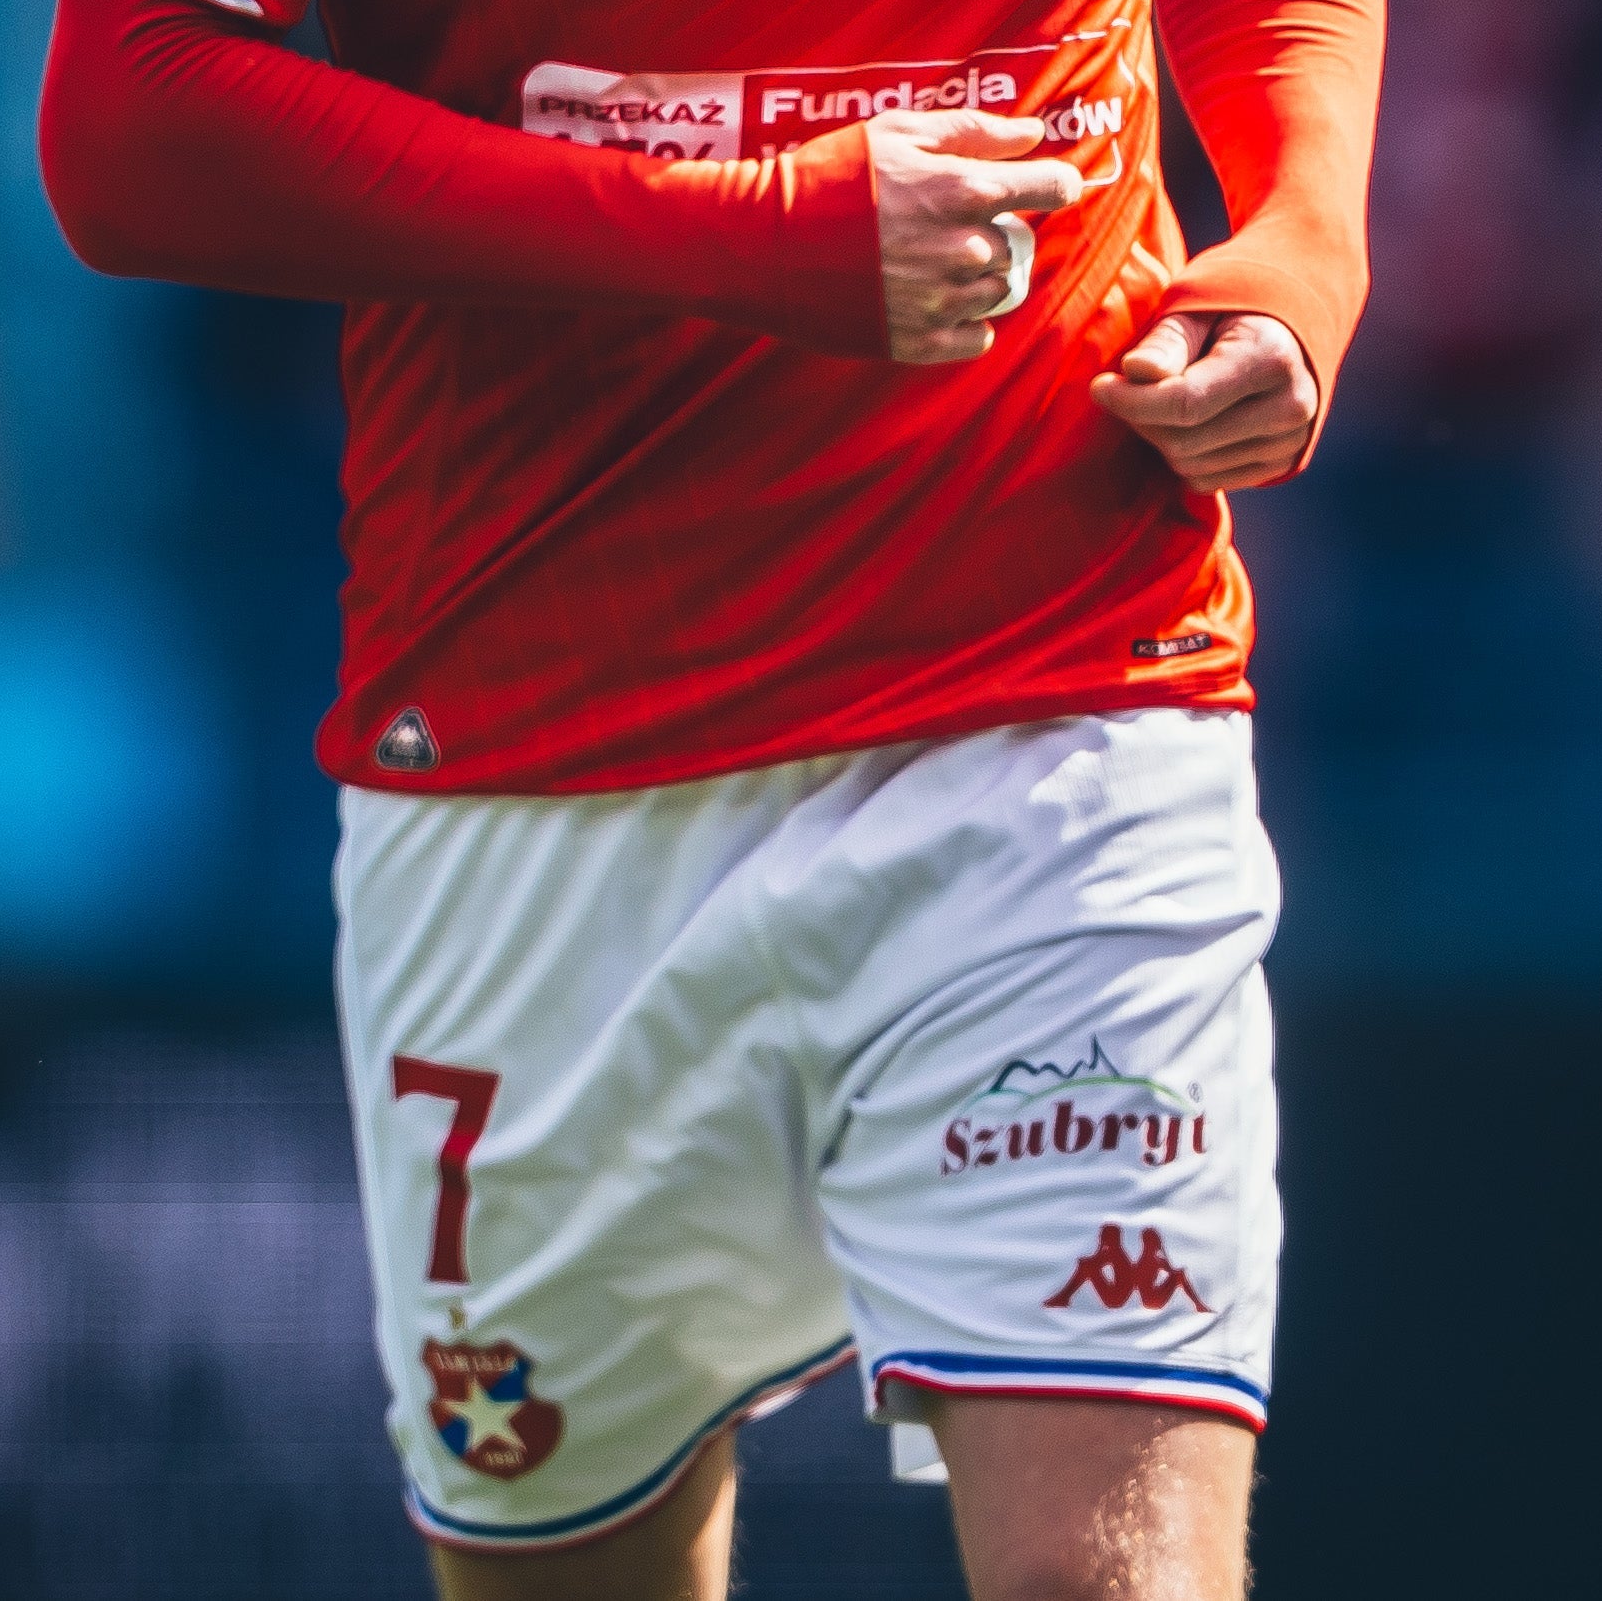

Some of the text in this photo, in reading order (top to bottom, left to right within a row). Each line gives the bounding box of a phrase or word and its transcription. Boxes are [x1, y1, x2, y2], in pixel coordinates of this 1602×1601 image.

[539, 95, 727, 126] PRZEKAŻ
[760, 67, 1018, 124] Fundacja
[390, 1054, 502, 1285] 7
